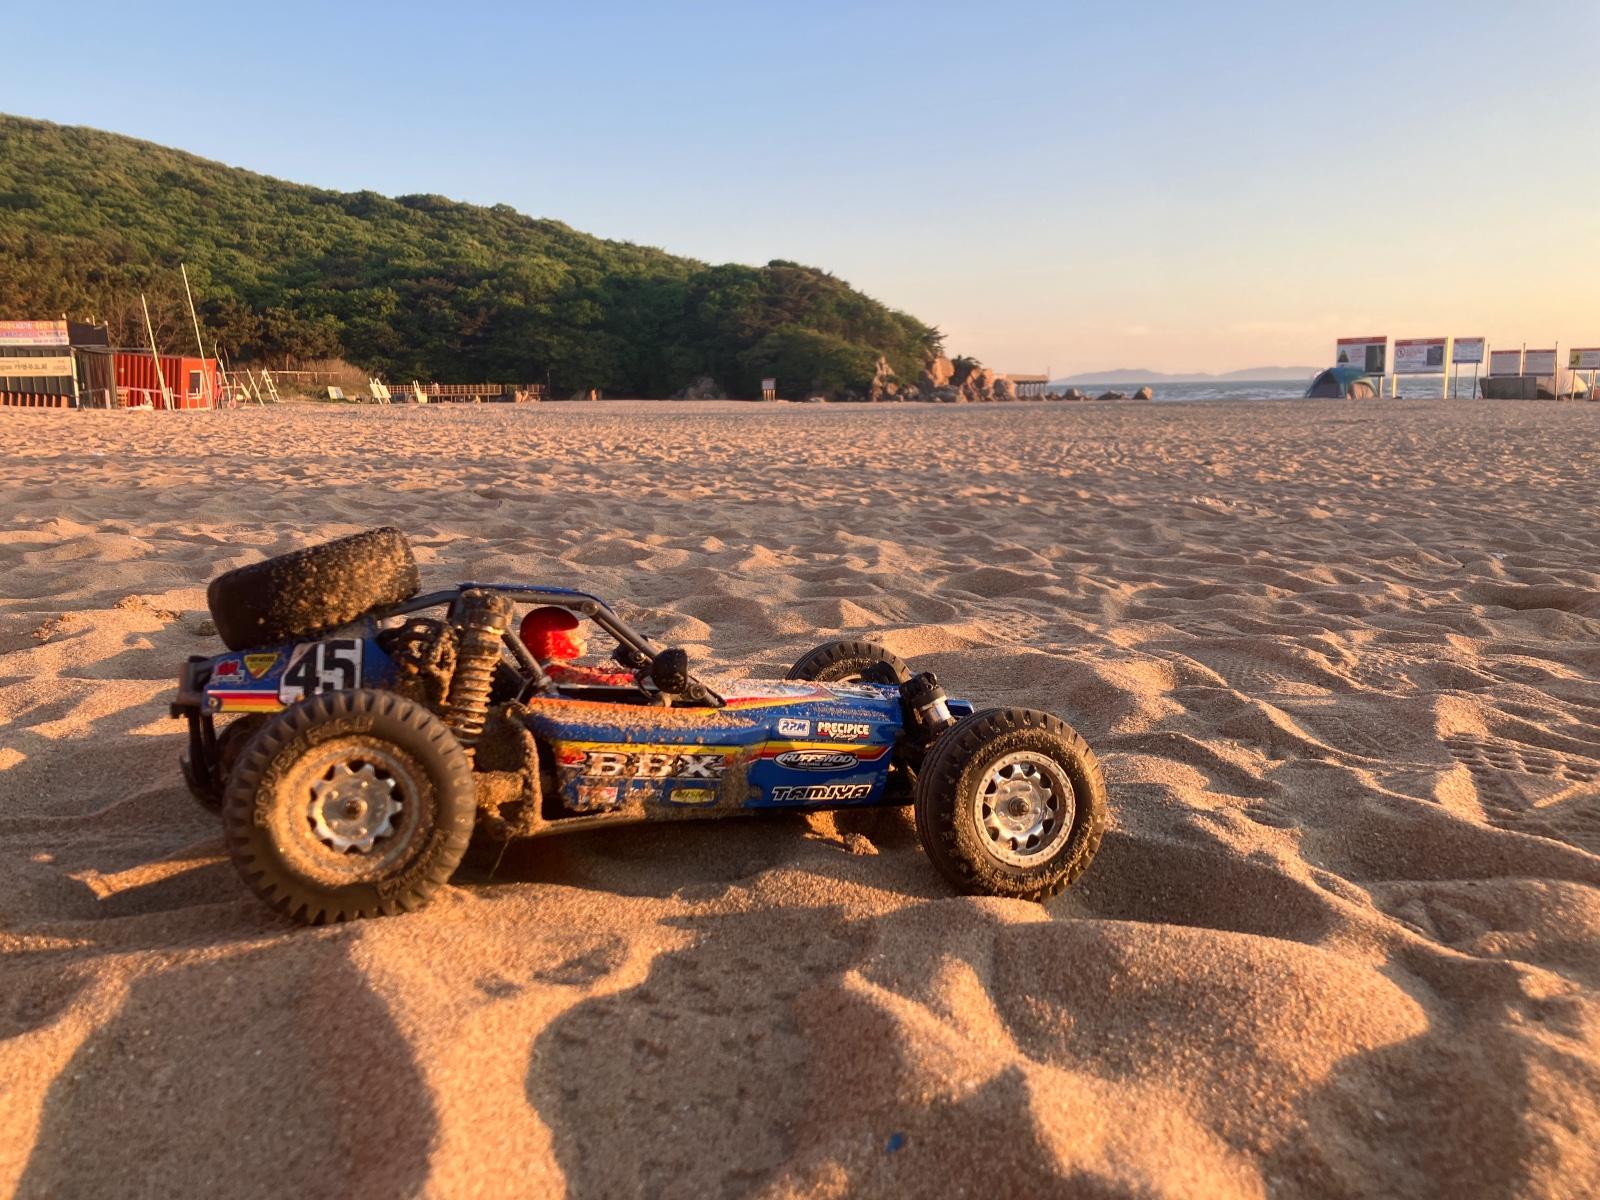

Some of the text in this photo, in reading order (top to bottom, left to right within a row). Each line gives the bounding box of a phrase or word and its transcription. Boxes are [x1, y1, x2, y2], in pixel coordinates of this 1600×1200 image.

[284, 640, 355, 697] 45
[782, 720, 806, 731] RPM
[817, 721, 870, 735] PRECIPICE
[586, 752, 724, 777] BBX
[782, 754, 852, 764] RUFFSHOD
[772, 785, 872, 800] TAMIYA
